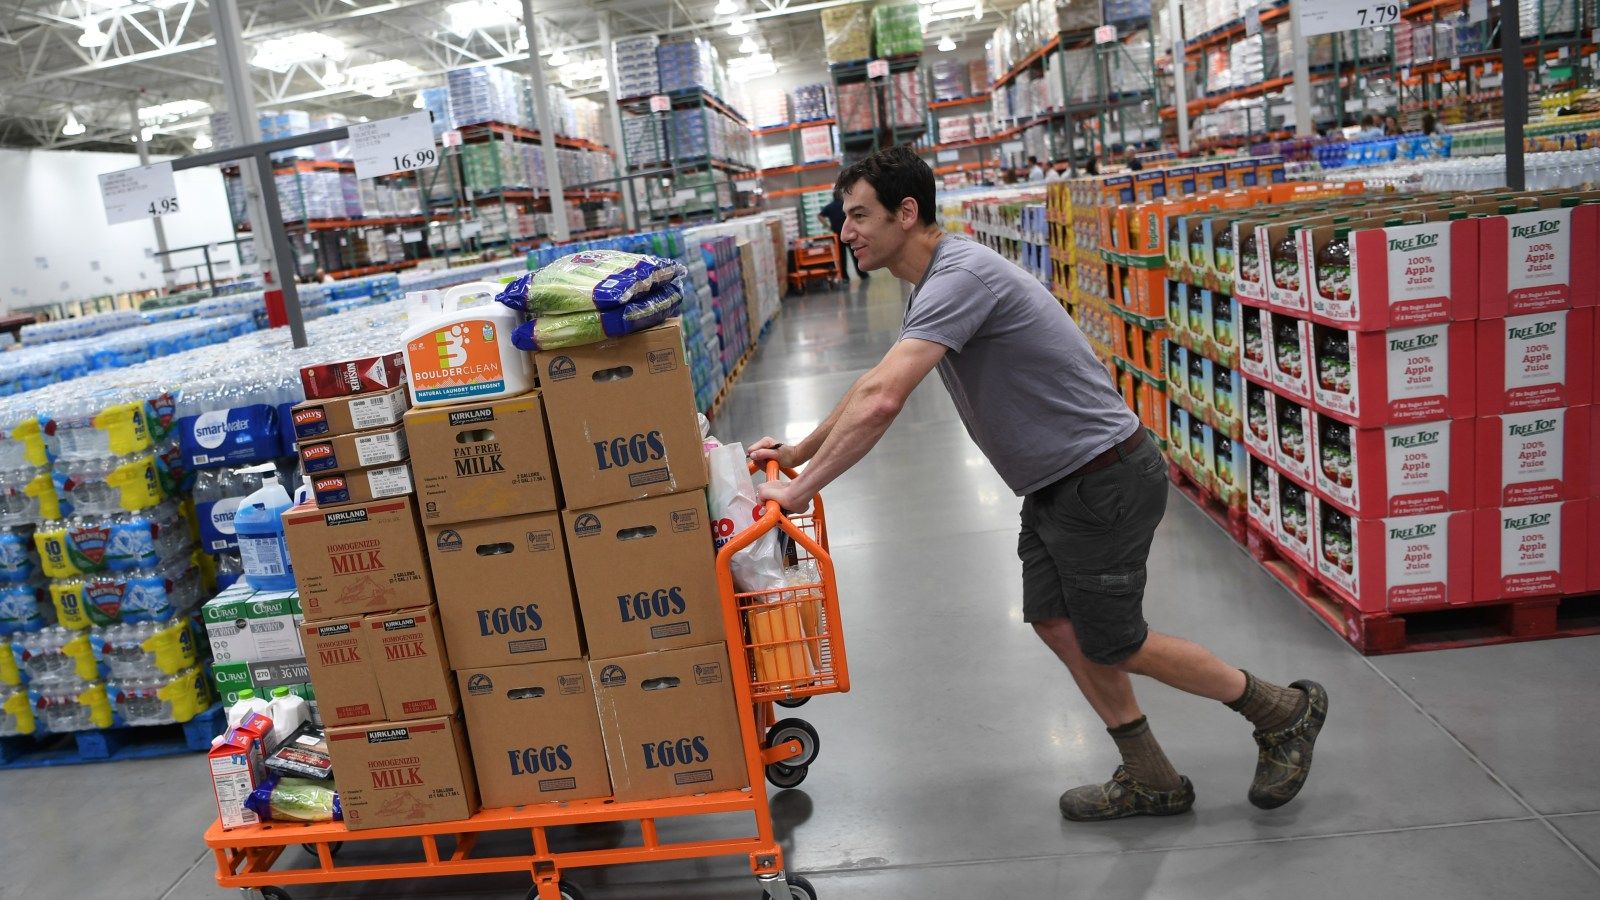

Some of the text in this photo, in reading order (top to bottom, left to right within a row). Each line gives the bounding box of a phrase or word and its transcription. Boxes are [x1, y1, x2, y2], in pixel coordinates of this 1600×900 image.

[1357, 5, 1398, 25] 7.79
[393, 150, 435, 171] 16.99
[148, 197, 179, 216] 4.95
[1512, 220, 1560, 238] TREE TOP
[1389, 234, 1438, 251] TREE TOP
[1529, 244, 1552, 252] 100%
[1408, 257, 1432, 265] 100%
[1525, 252, 1555, 263] Apple
[1405, 265, 1435, 276] Apple
[1527, 264, 1551, 272] Juice
[1509, 322, 1557, 340] TREE TOP
[1390, 334, 1438, 352] TREE TOP
[1526, 345, 1549, 353] 100%
[1408, 357, 1431, 365] 100%
[1523, 353, 1550, 363] Apple
[1404, 365, 1433, 375] Apple
[346, 363, 360, 391] KOSHER
[443, 386, 468, 394] LAUNDRY
[470, 383, 500, 391] DETERGENT
[296, 410, 322, 422] DAILY'S
[452, 409, 491, 421] KIRKLAND
[1510, 419, 1556, 436] TREE TOP
[1392, 431, 1439, 448] TREE TOP
[305, 446, 330, 457] DAILY'S
[454, 443, 500, 457] FAT FREE
[594, 430, 665, 470] EGGS
[1519, 450, 1547, 460] Apple
[1405, 453, 1428, 461] 100%
[455, 454, 505, 476] MILK
[1402, 462, 1430, 471] Apple
[1521, 460, 1544, 468] Juice
[317, 479, 343, 490] DAILY'S
[327, 510, 366, 520] KIRKLAND
[1504, 514, 1551, 530] TREE TOP
[1390, 524, 1436, 540] TREE TOP
[1522, 534, 1544, 542] 100%
[327, 539, 380, 552] HOMOGENIZED
[1519, 542, 1546, 551] Apple
[1404, 553, 1431, 562] Apple
[1521, 552, 1543, 560] Juice
[331, 551, 384, 574] MILK
[253, 603, 282, 615] CURAD
[617, 587, 686, 622] EGGS
[209, 607, 238, 619] CURAD
[385, 619, 414, 627] KIRKLAND
[477, 604, 542, 636] EGGS
[320, 625, 349, 633] KIRKLAND
[319, 647, 361, 665] MILK
[385, 642, 427, 660] MILK
[216, 672, 247, 682] CURAD
[280, 669, 292, 679] 3G
[369, 730, 407, 739] KIRKLAND
[642, 736, 709, 769] EGGS
[368, 757, 420, 767] HOMOGENIZED
[508, 744, 572, 776] EGGS
[371, 767, 423, 788] MILK
